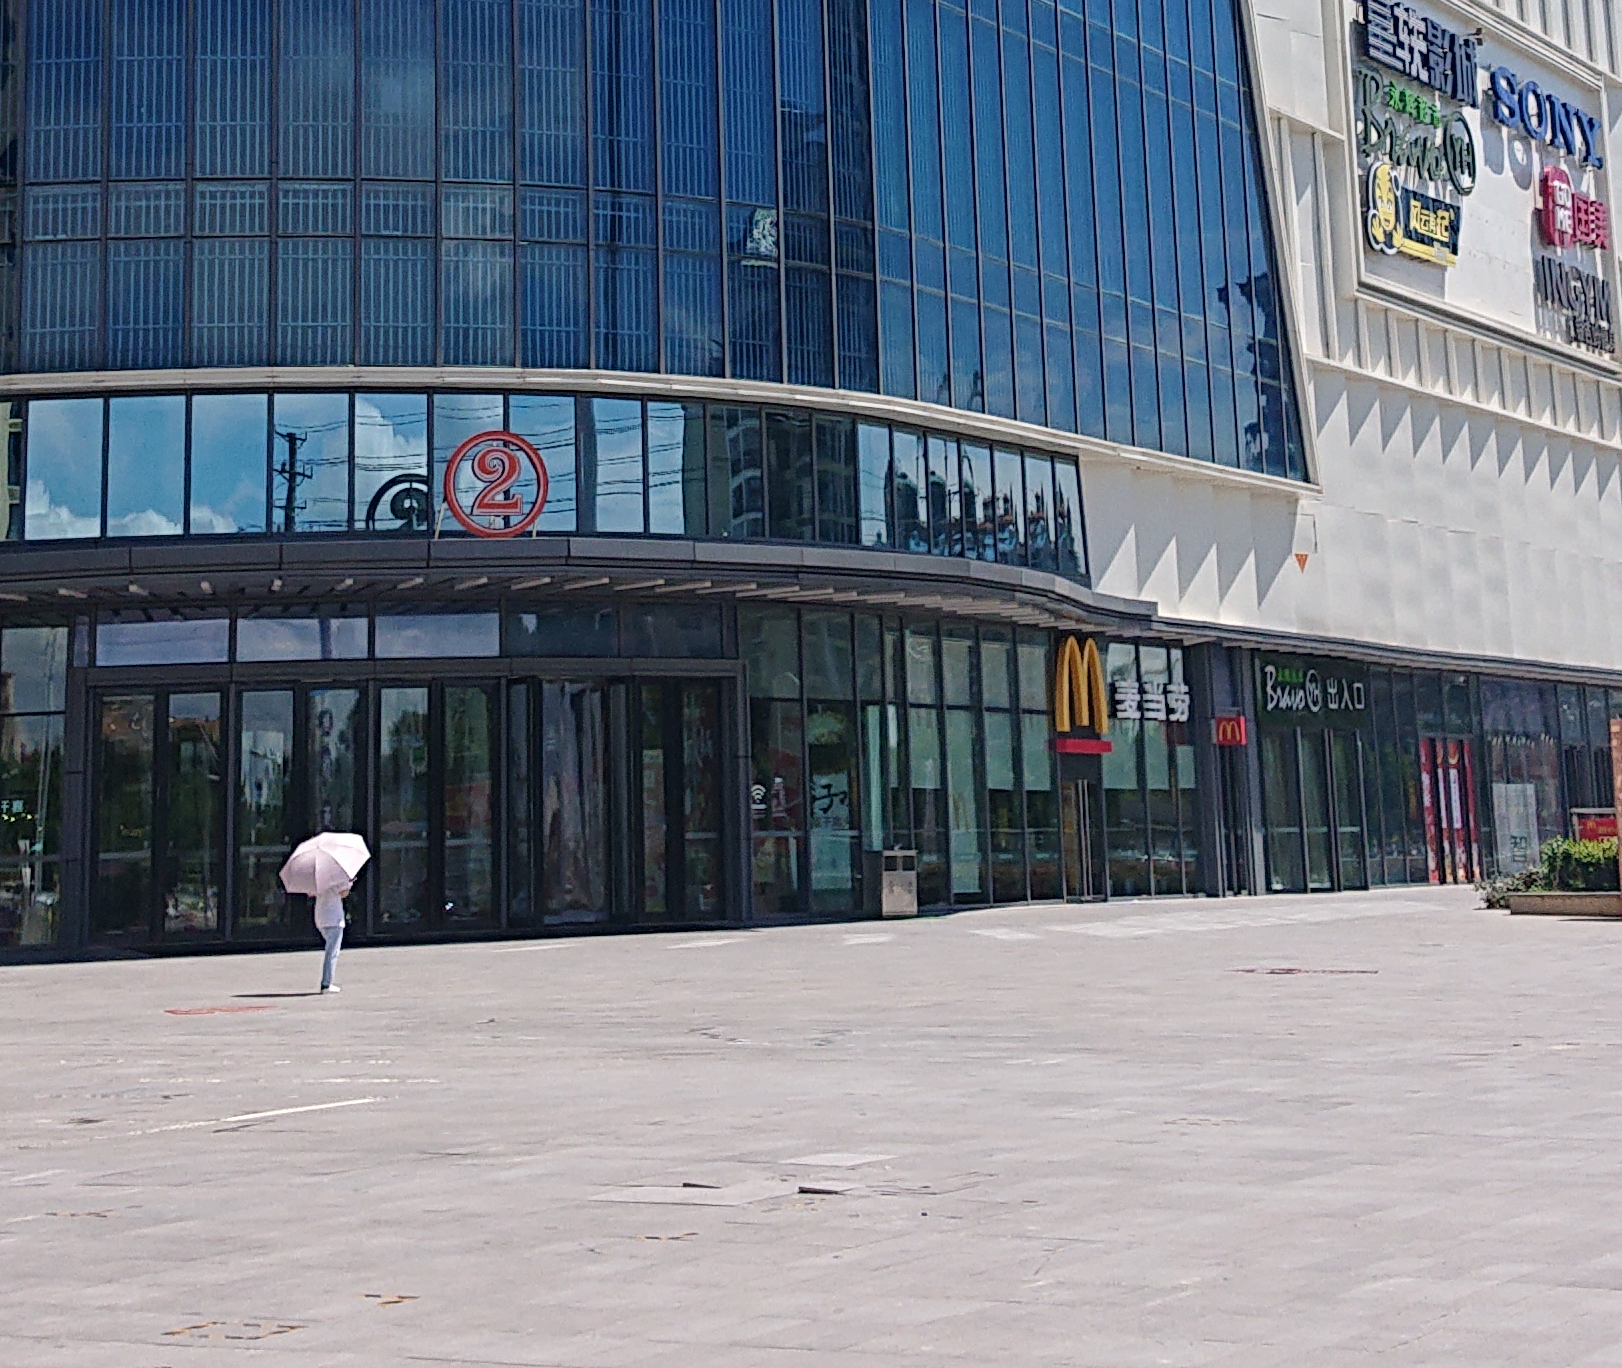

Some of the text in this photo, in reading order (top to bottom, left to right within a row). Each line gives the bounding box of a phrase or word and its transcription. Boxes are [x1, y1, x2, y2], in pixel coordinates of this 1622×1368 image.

[1490, 66, 1604, 170] SONY
[1114, 679, 1191, 724] 麦当劳
[1325, 677, 1366, 711] 出入口
